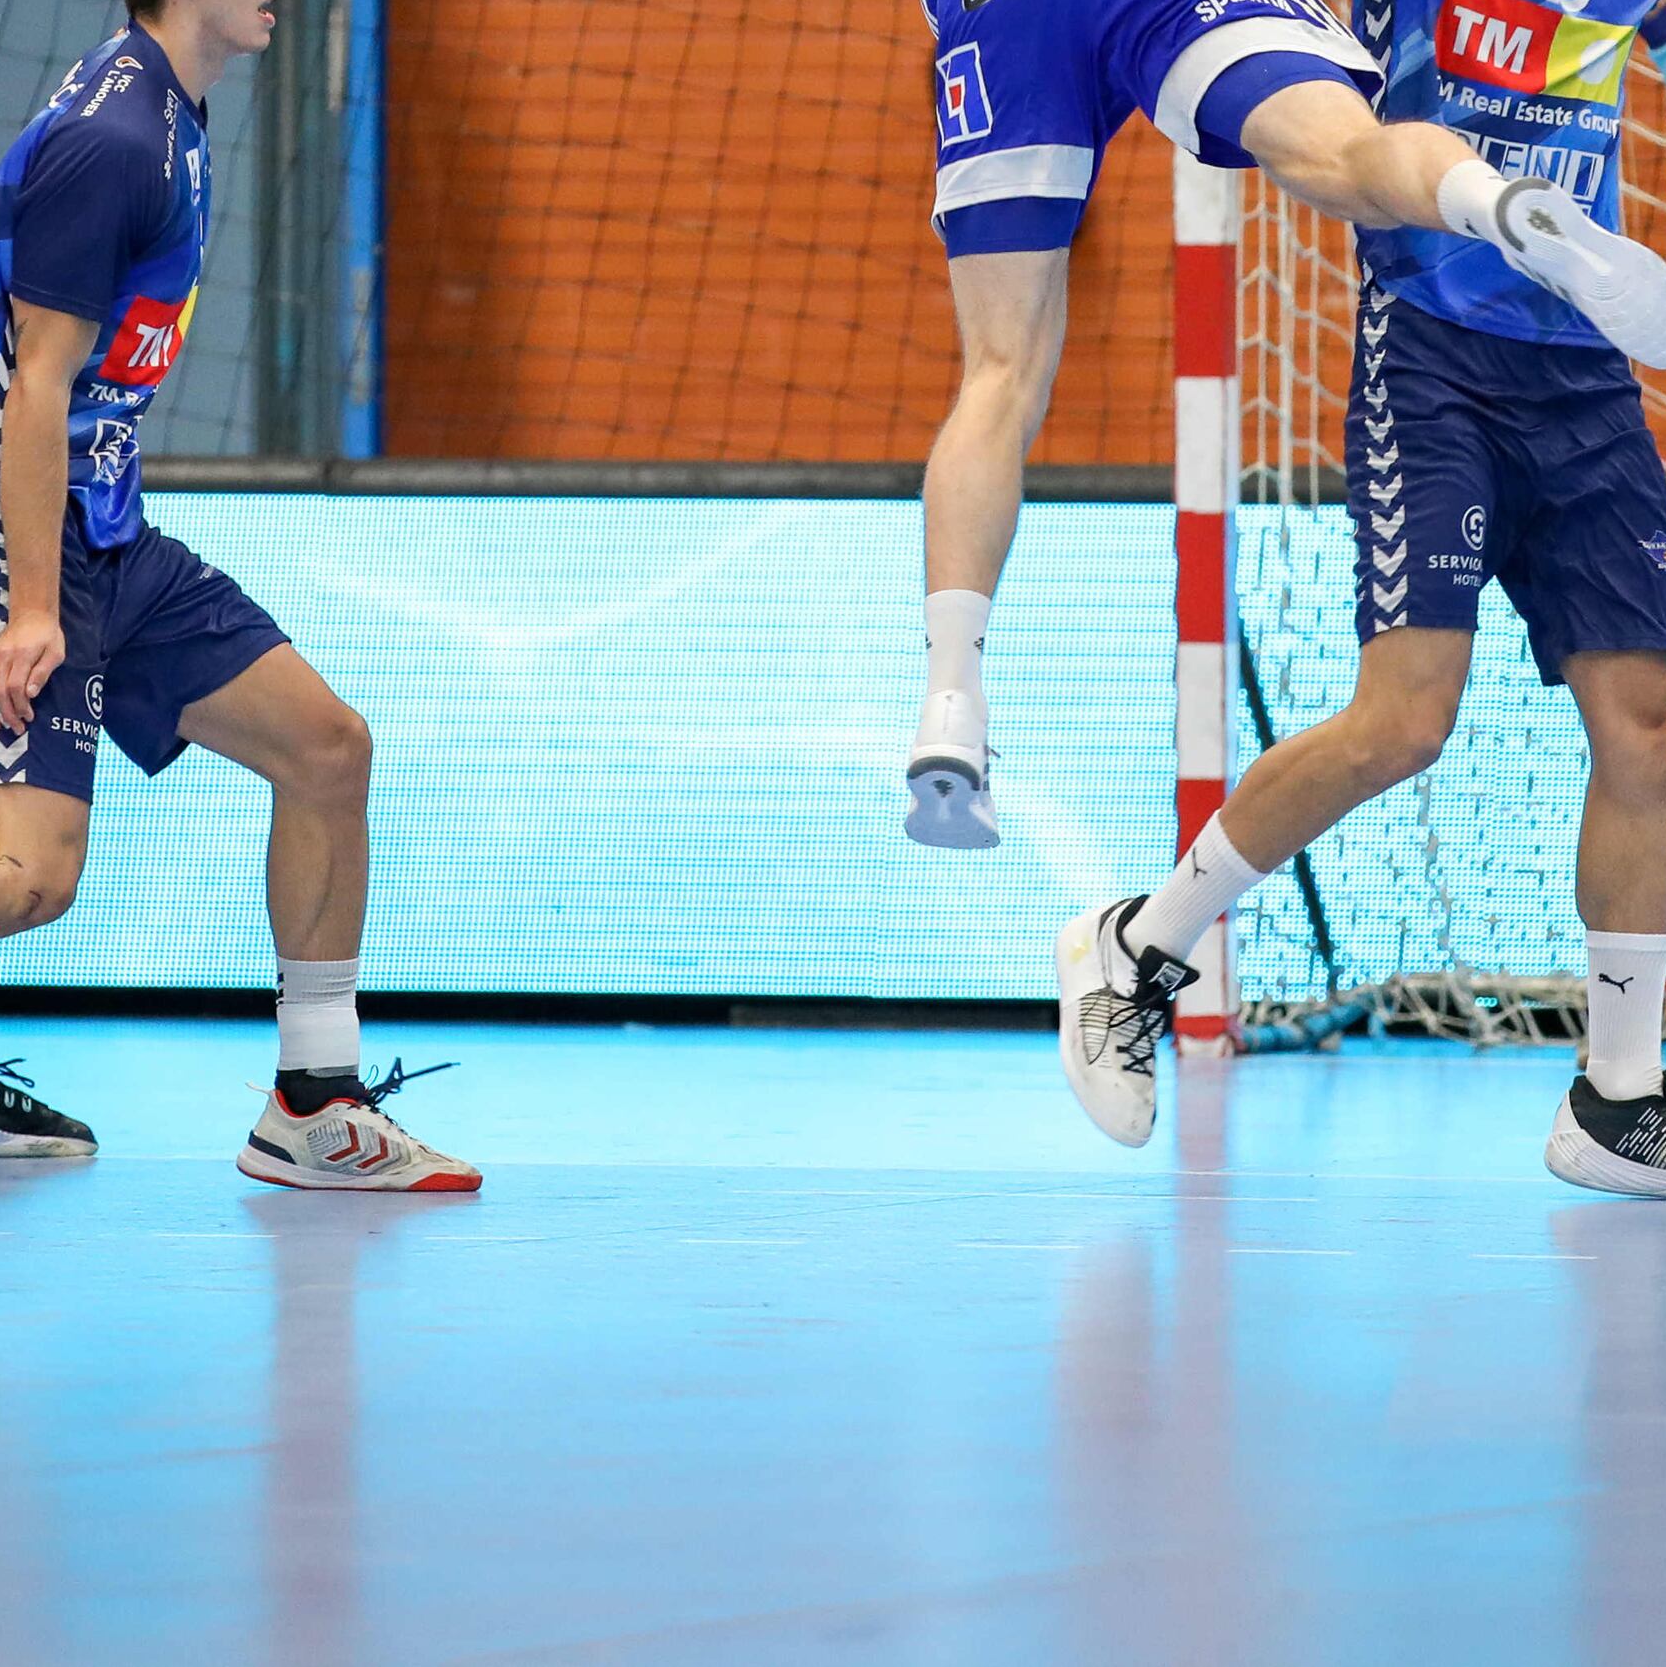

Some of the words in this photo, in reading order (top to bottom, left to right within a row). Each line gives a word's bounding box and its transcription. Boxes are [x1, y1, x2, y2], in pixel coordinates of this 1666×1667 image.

[1452, 5, 1533, 75] TM
[113, 73, 134, 93] VCC
[1459, 85, 1511, 118] Real
[1515, 101, 1574, 127] Estate
